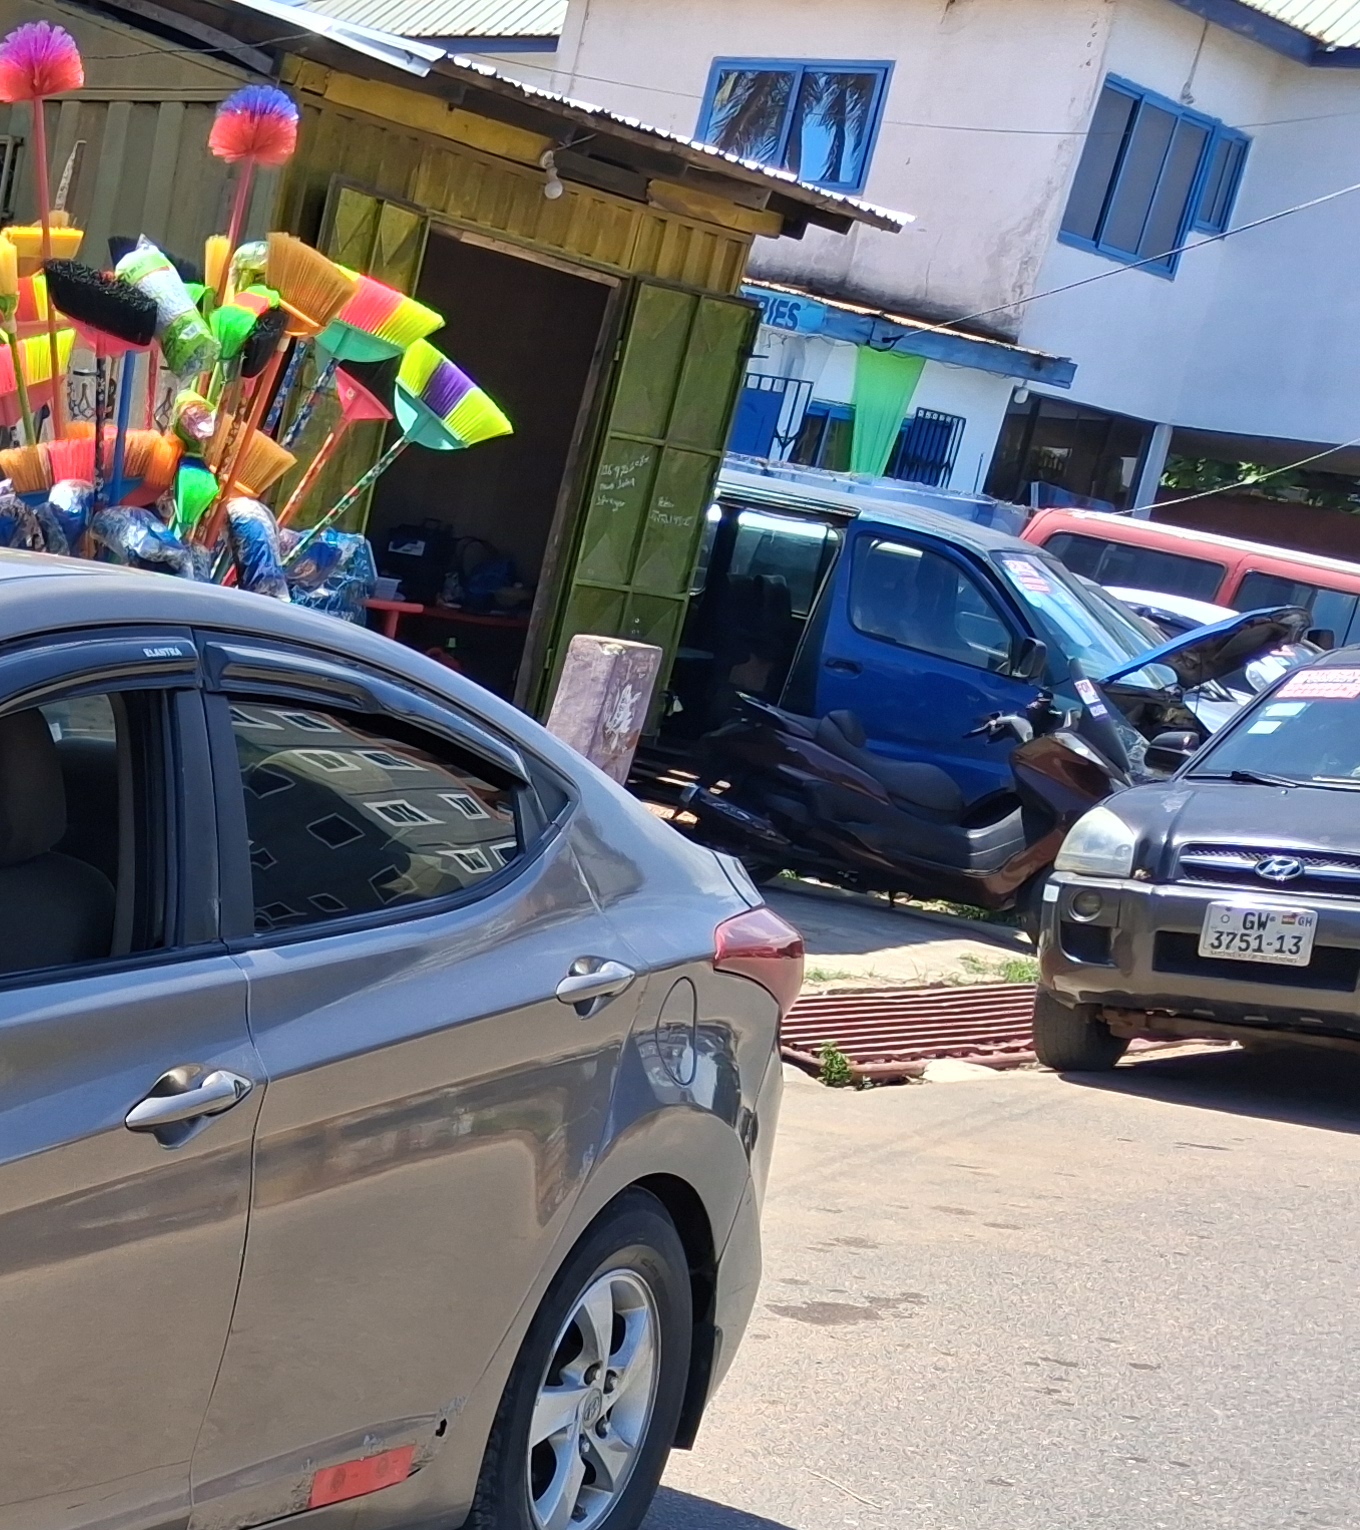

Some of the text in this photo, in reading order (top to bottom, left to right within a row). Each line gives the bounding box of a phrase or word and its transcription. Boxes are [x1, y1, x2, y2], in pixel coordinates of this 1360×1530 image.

[1243, 911, 1313, 931] GW GH
[1209, 930, 1303, 955] 3751-13
